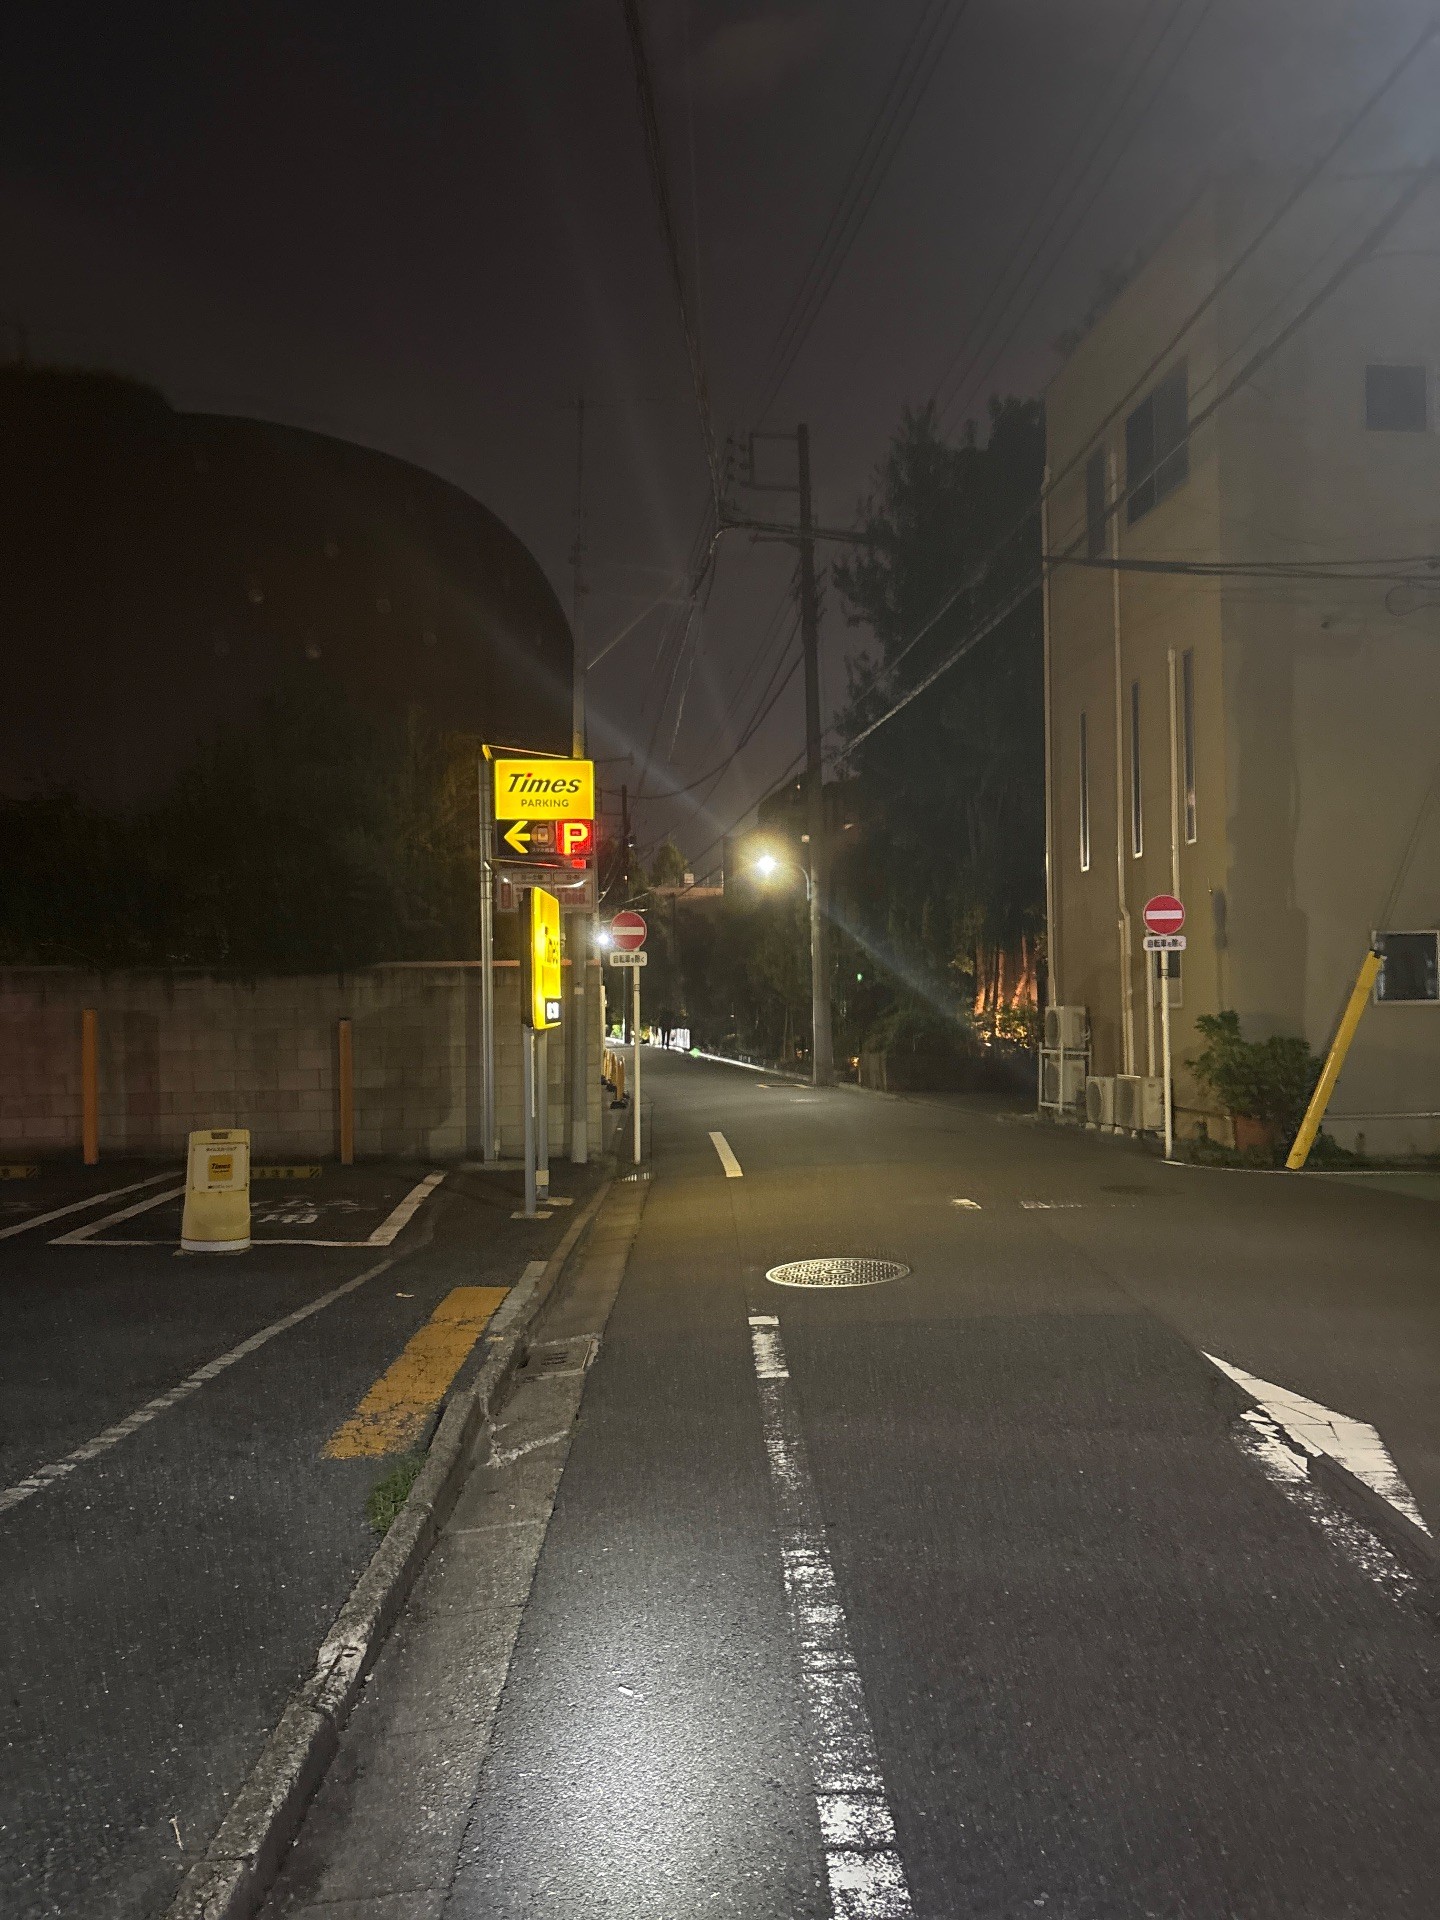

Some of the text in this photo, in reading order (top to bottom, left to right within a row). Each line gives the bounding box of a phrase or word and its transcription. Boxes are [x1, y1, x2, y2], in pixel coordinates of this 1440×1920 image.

[508, 772, 582, 793] Times
[521, 799, 570, 808] PARKING
[563, 822, 588, 855] P
[1148, 939, 1183, 948] 自転車を除く
[612, 954, 644, 964] 自転車を除く
